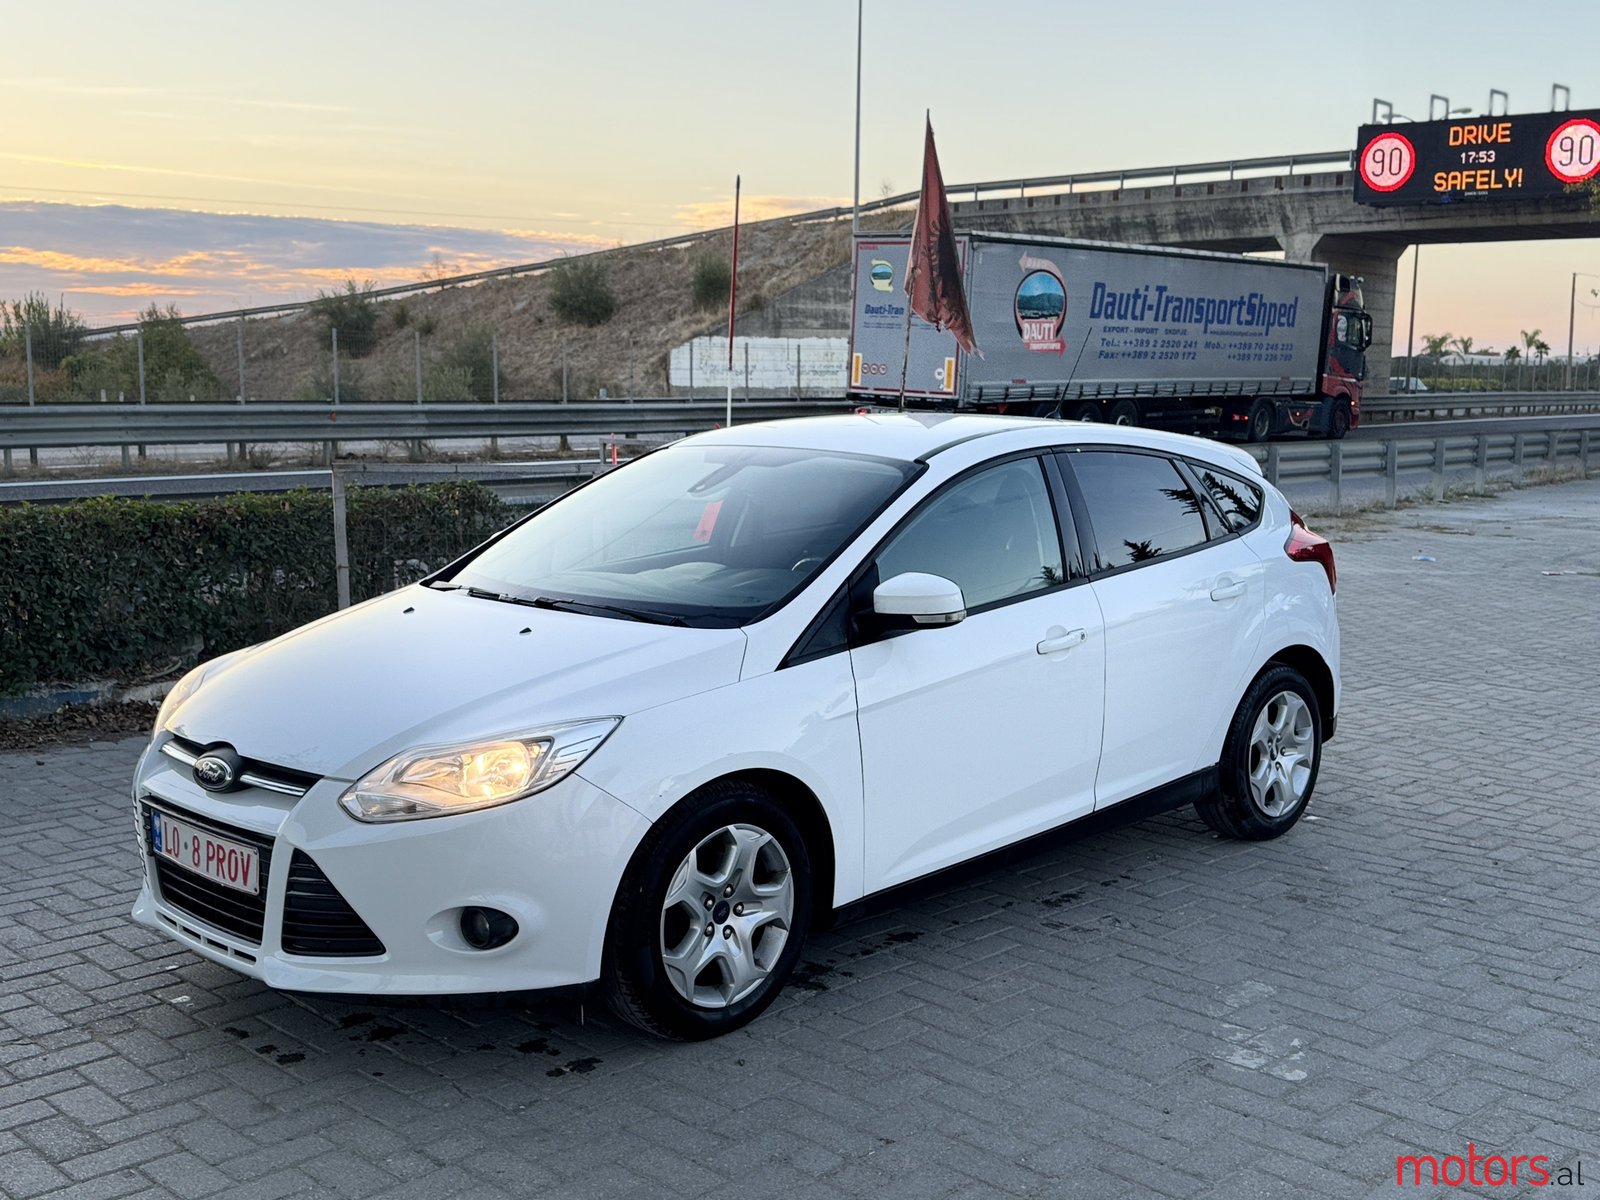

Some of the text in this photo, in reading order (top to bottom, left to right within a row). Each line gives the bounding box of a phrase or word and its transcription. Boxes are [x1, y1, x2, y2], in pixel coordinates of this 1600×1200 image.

[1449, 122, 1512, 146] DRIVE
[1371, 147, 1403, 177] 90
[1460, 150, 1496, 164] 17:53
[1559, 135, 1595, 167] 90
[1433, 168, 1524, 192] SAFELY!
[1089, 282, 1299, 337] Dauti-TransportShped
[1023, 322, 1055, 340] DAUTI
[1103, 326, 1129, 334] EXPORT
[1134, 327, 1159, 335] IMPORT
[1098, 350, 1119, 359] Fax:
[1183, 340, 1198, 349] 241
[192, 834, 200, 867] 8
[206, 840, 252, 886] PROV
